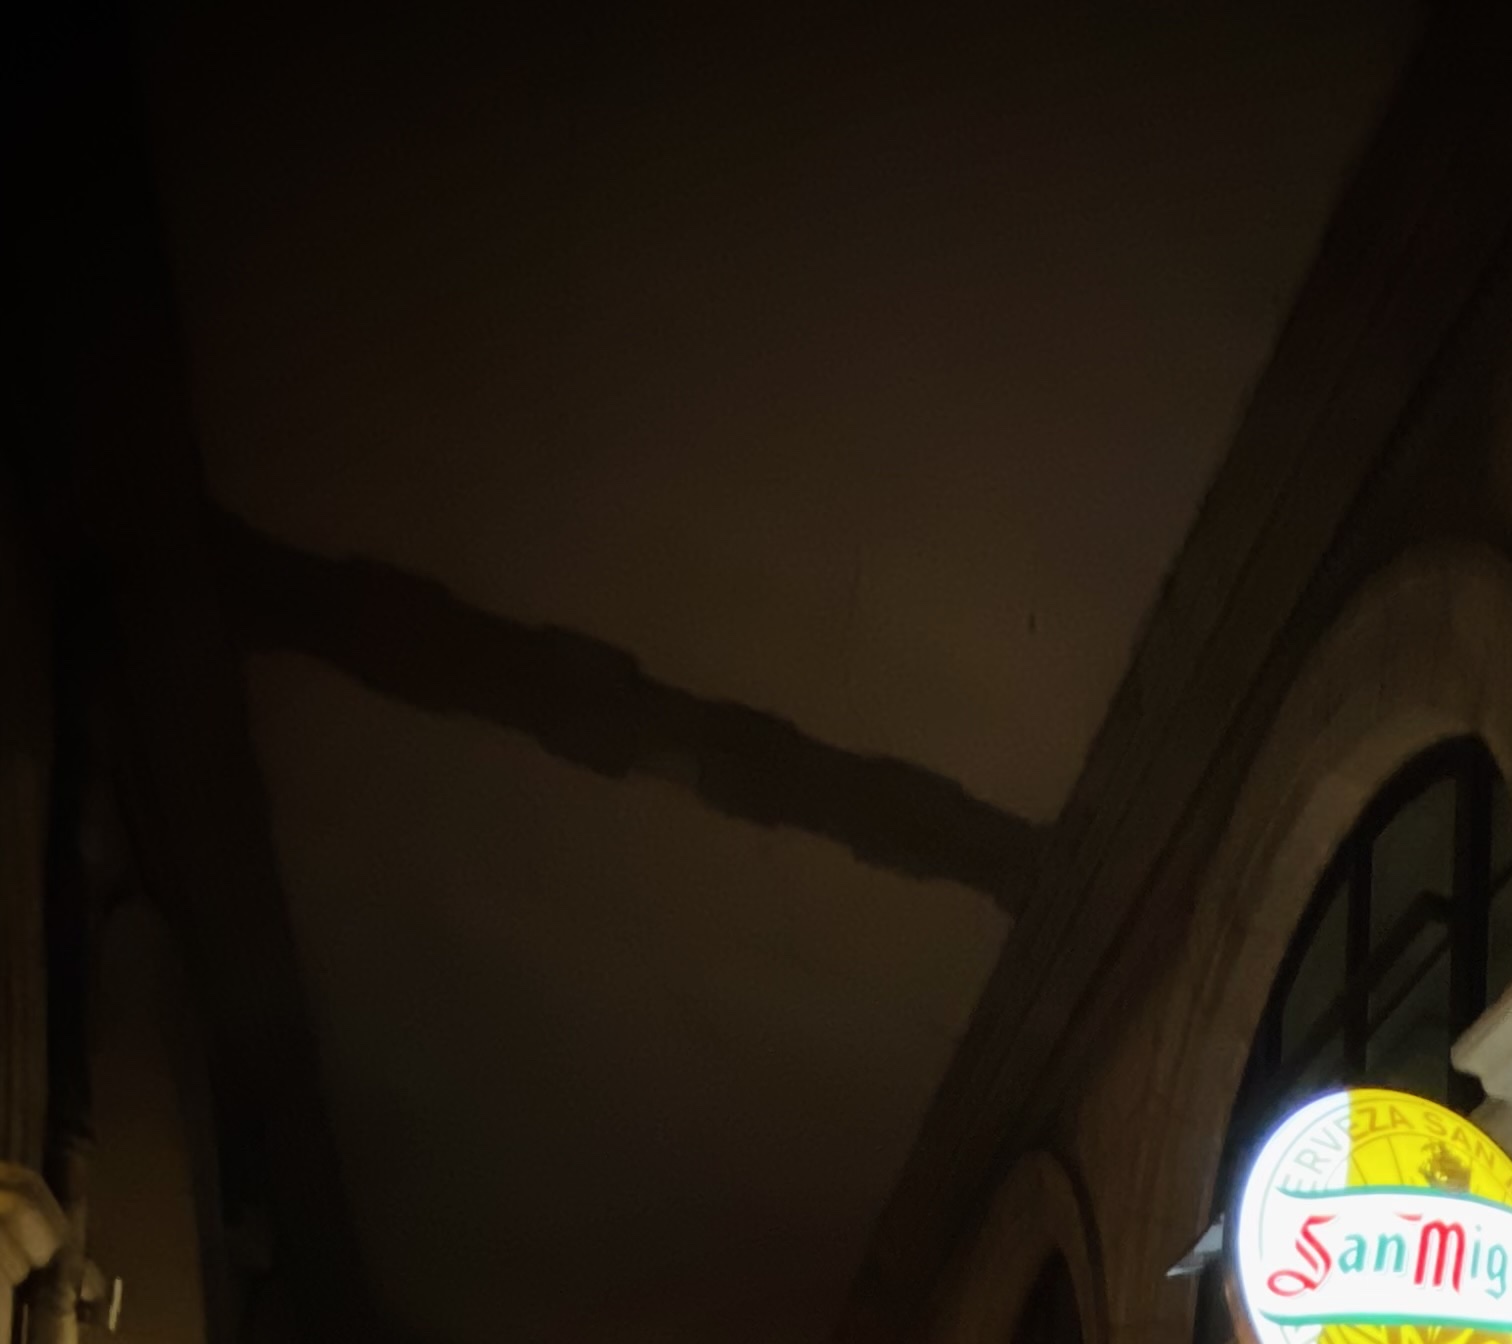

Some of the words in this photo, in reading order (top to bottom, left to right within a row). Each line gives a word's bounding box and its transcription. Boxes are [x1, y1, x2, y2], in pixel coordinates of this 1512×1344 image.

[1282, 1103, 1415, 1191] ERVEZA
[1423, 1109, 1496, 1170] SAN
[1267, 1213, 1406, 1298] San
